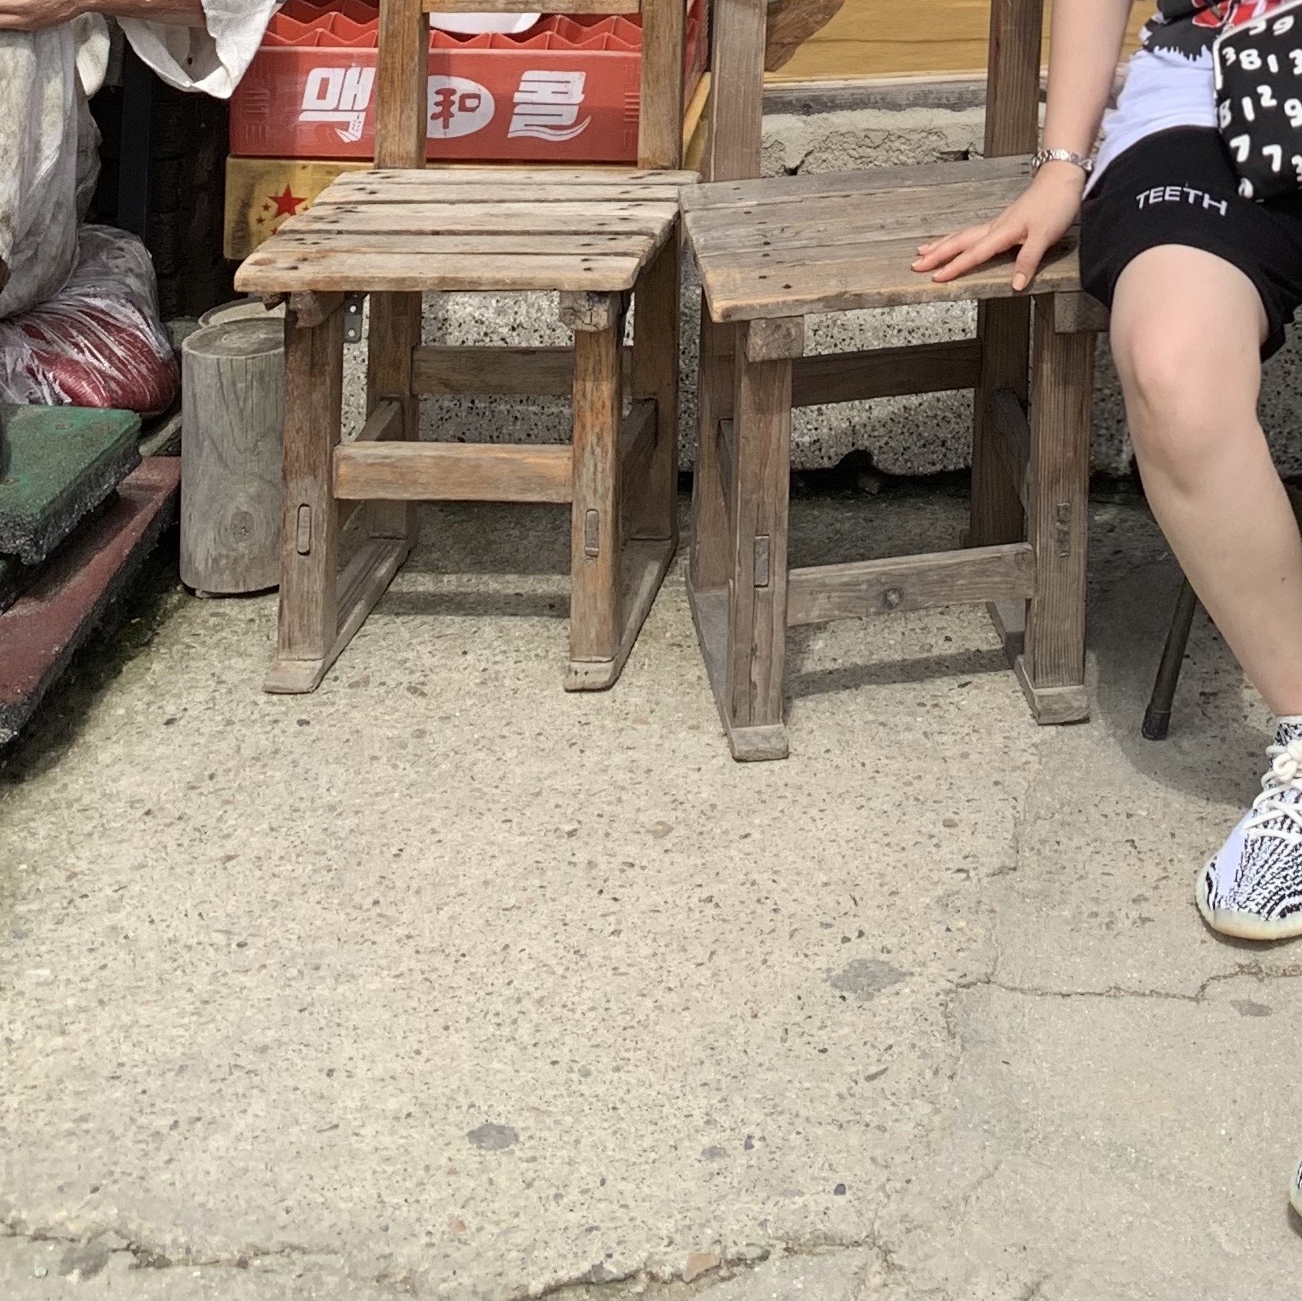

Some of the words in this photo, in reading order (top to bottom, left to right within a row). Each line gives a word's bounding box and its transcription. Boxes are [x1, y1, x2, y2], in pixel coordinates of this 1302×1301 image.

[1239, 48, 1262, 70] 8
[1256, 84, 1278, 108] 2
[1229, 134, 1251, 162] 7
[1262, 144, 1282, 173] 7
[1135, 185, 1228, 217] TEETH
